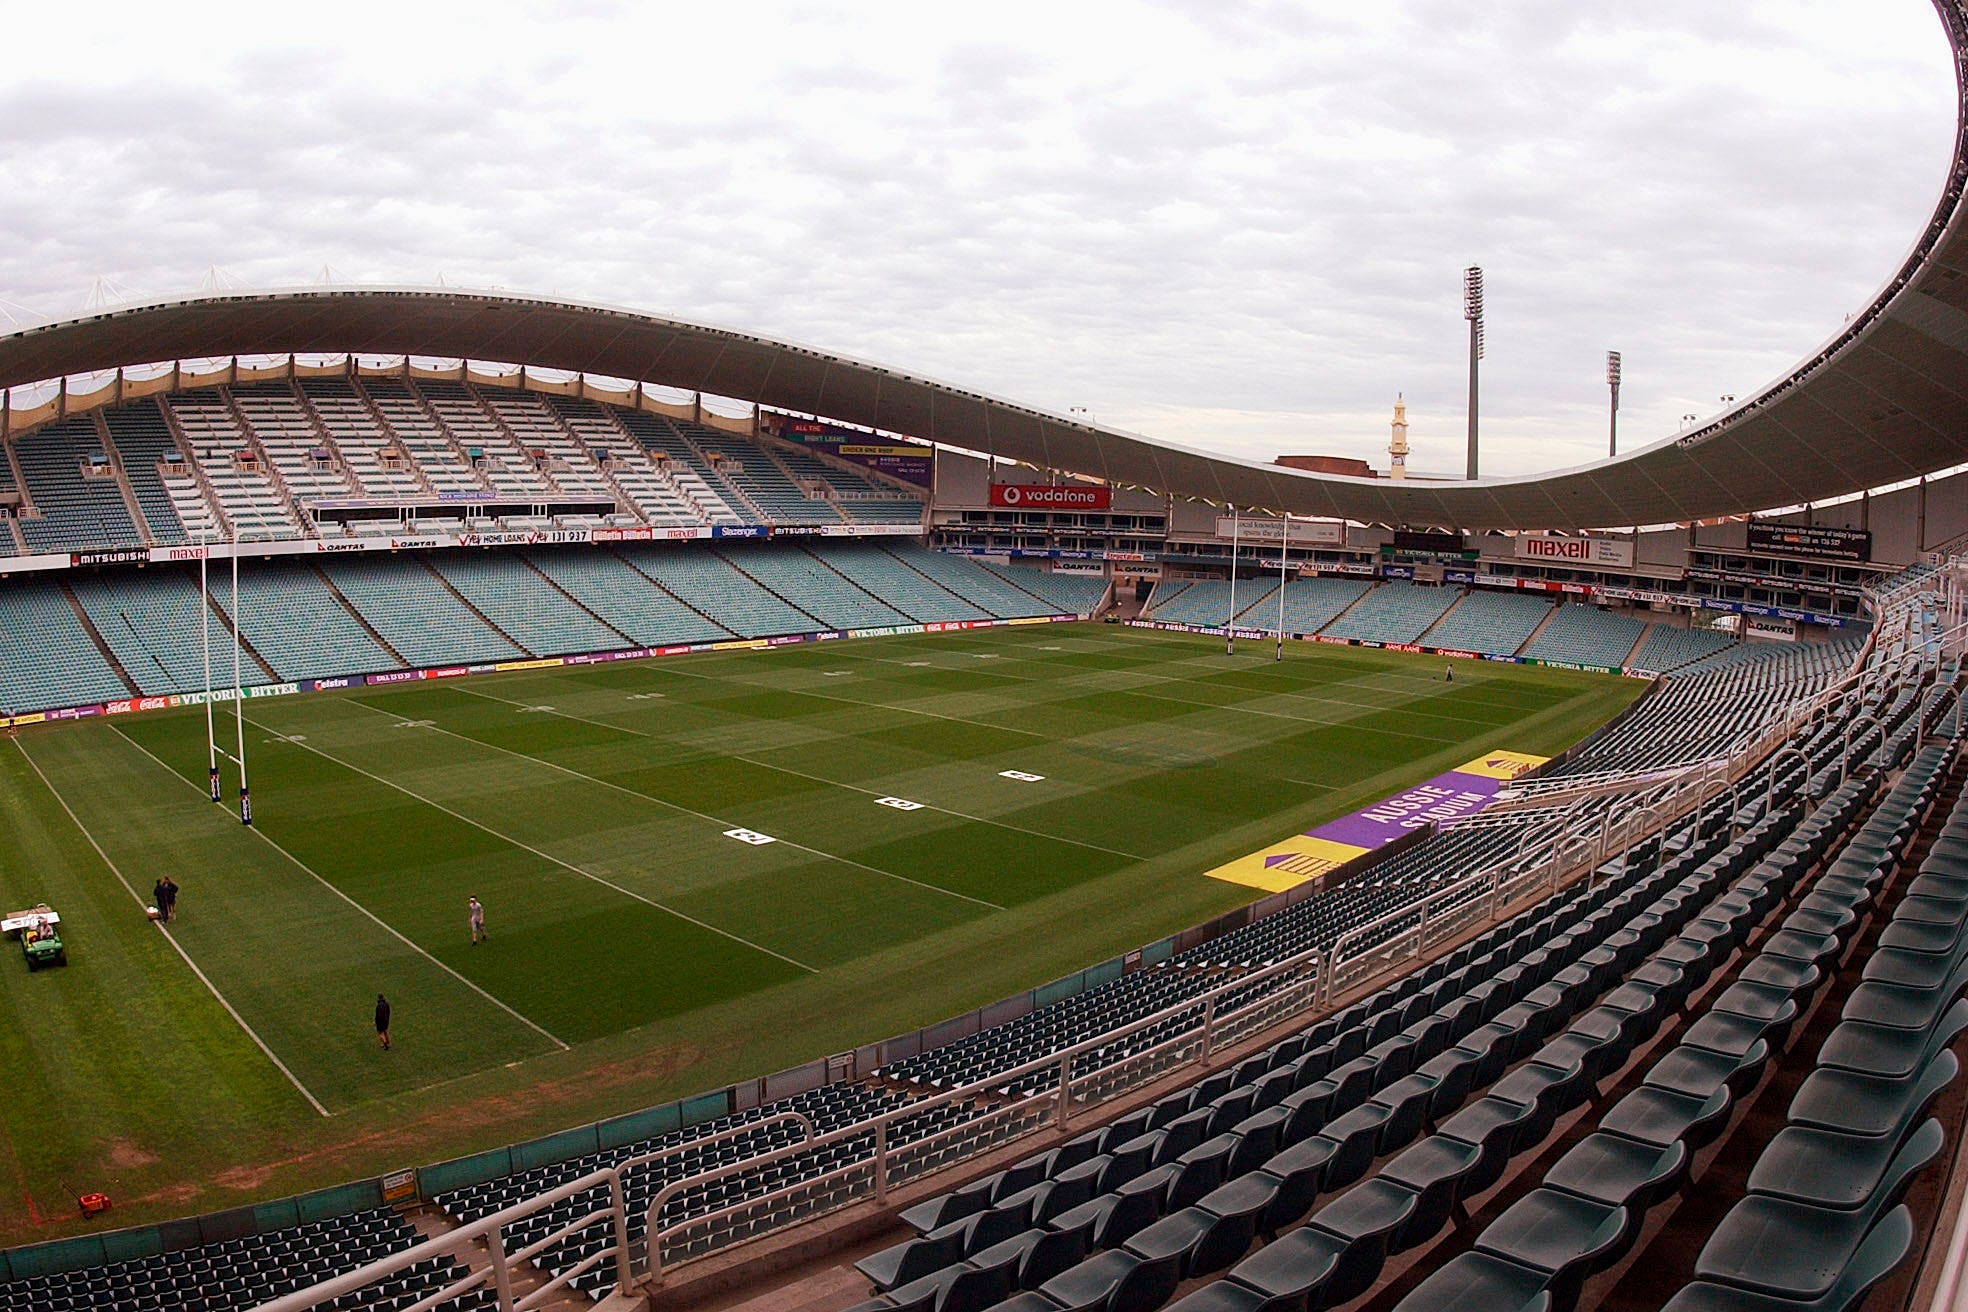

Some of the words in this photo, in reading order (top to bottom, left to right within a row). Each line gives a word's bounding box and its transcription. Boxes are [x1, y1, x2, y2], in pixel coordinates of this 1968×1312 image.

[1025, 489, 1096, 503] vodafone
[552, 531, 565, 542] 131
[721, 526, 757, 538] Slazenger
[326, 543, 365, 551] QANTAS
[400, 540, 437, 548] QANTAS
[1527, 539, 1590, 559] maxell
[80, 551, 150, 565] MITSUBISHI
[169, 547, 209, 560] maxel
[1062, 563, 1101, 571] QANTAS
[1124, 566, 1159, 574] QANTAS
[856, 629, 895, 639] VICTORIA
[1757, 622, 1794, 635] QANTAS
[1546, 661, 1581, 671] VICTORIA
[250, 682, 299, 699] BITTER
[314, 678, 348, 691] Telstra
[1360, 785, 1455, 825] AUSSIE
[1399, 791, 1488, 829] STADIUM
